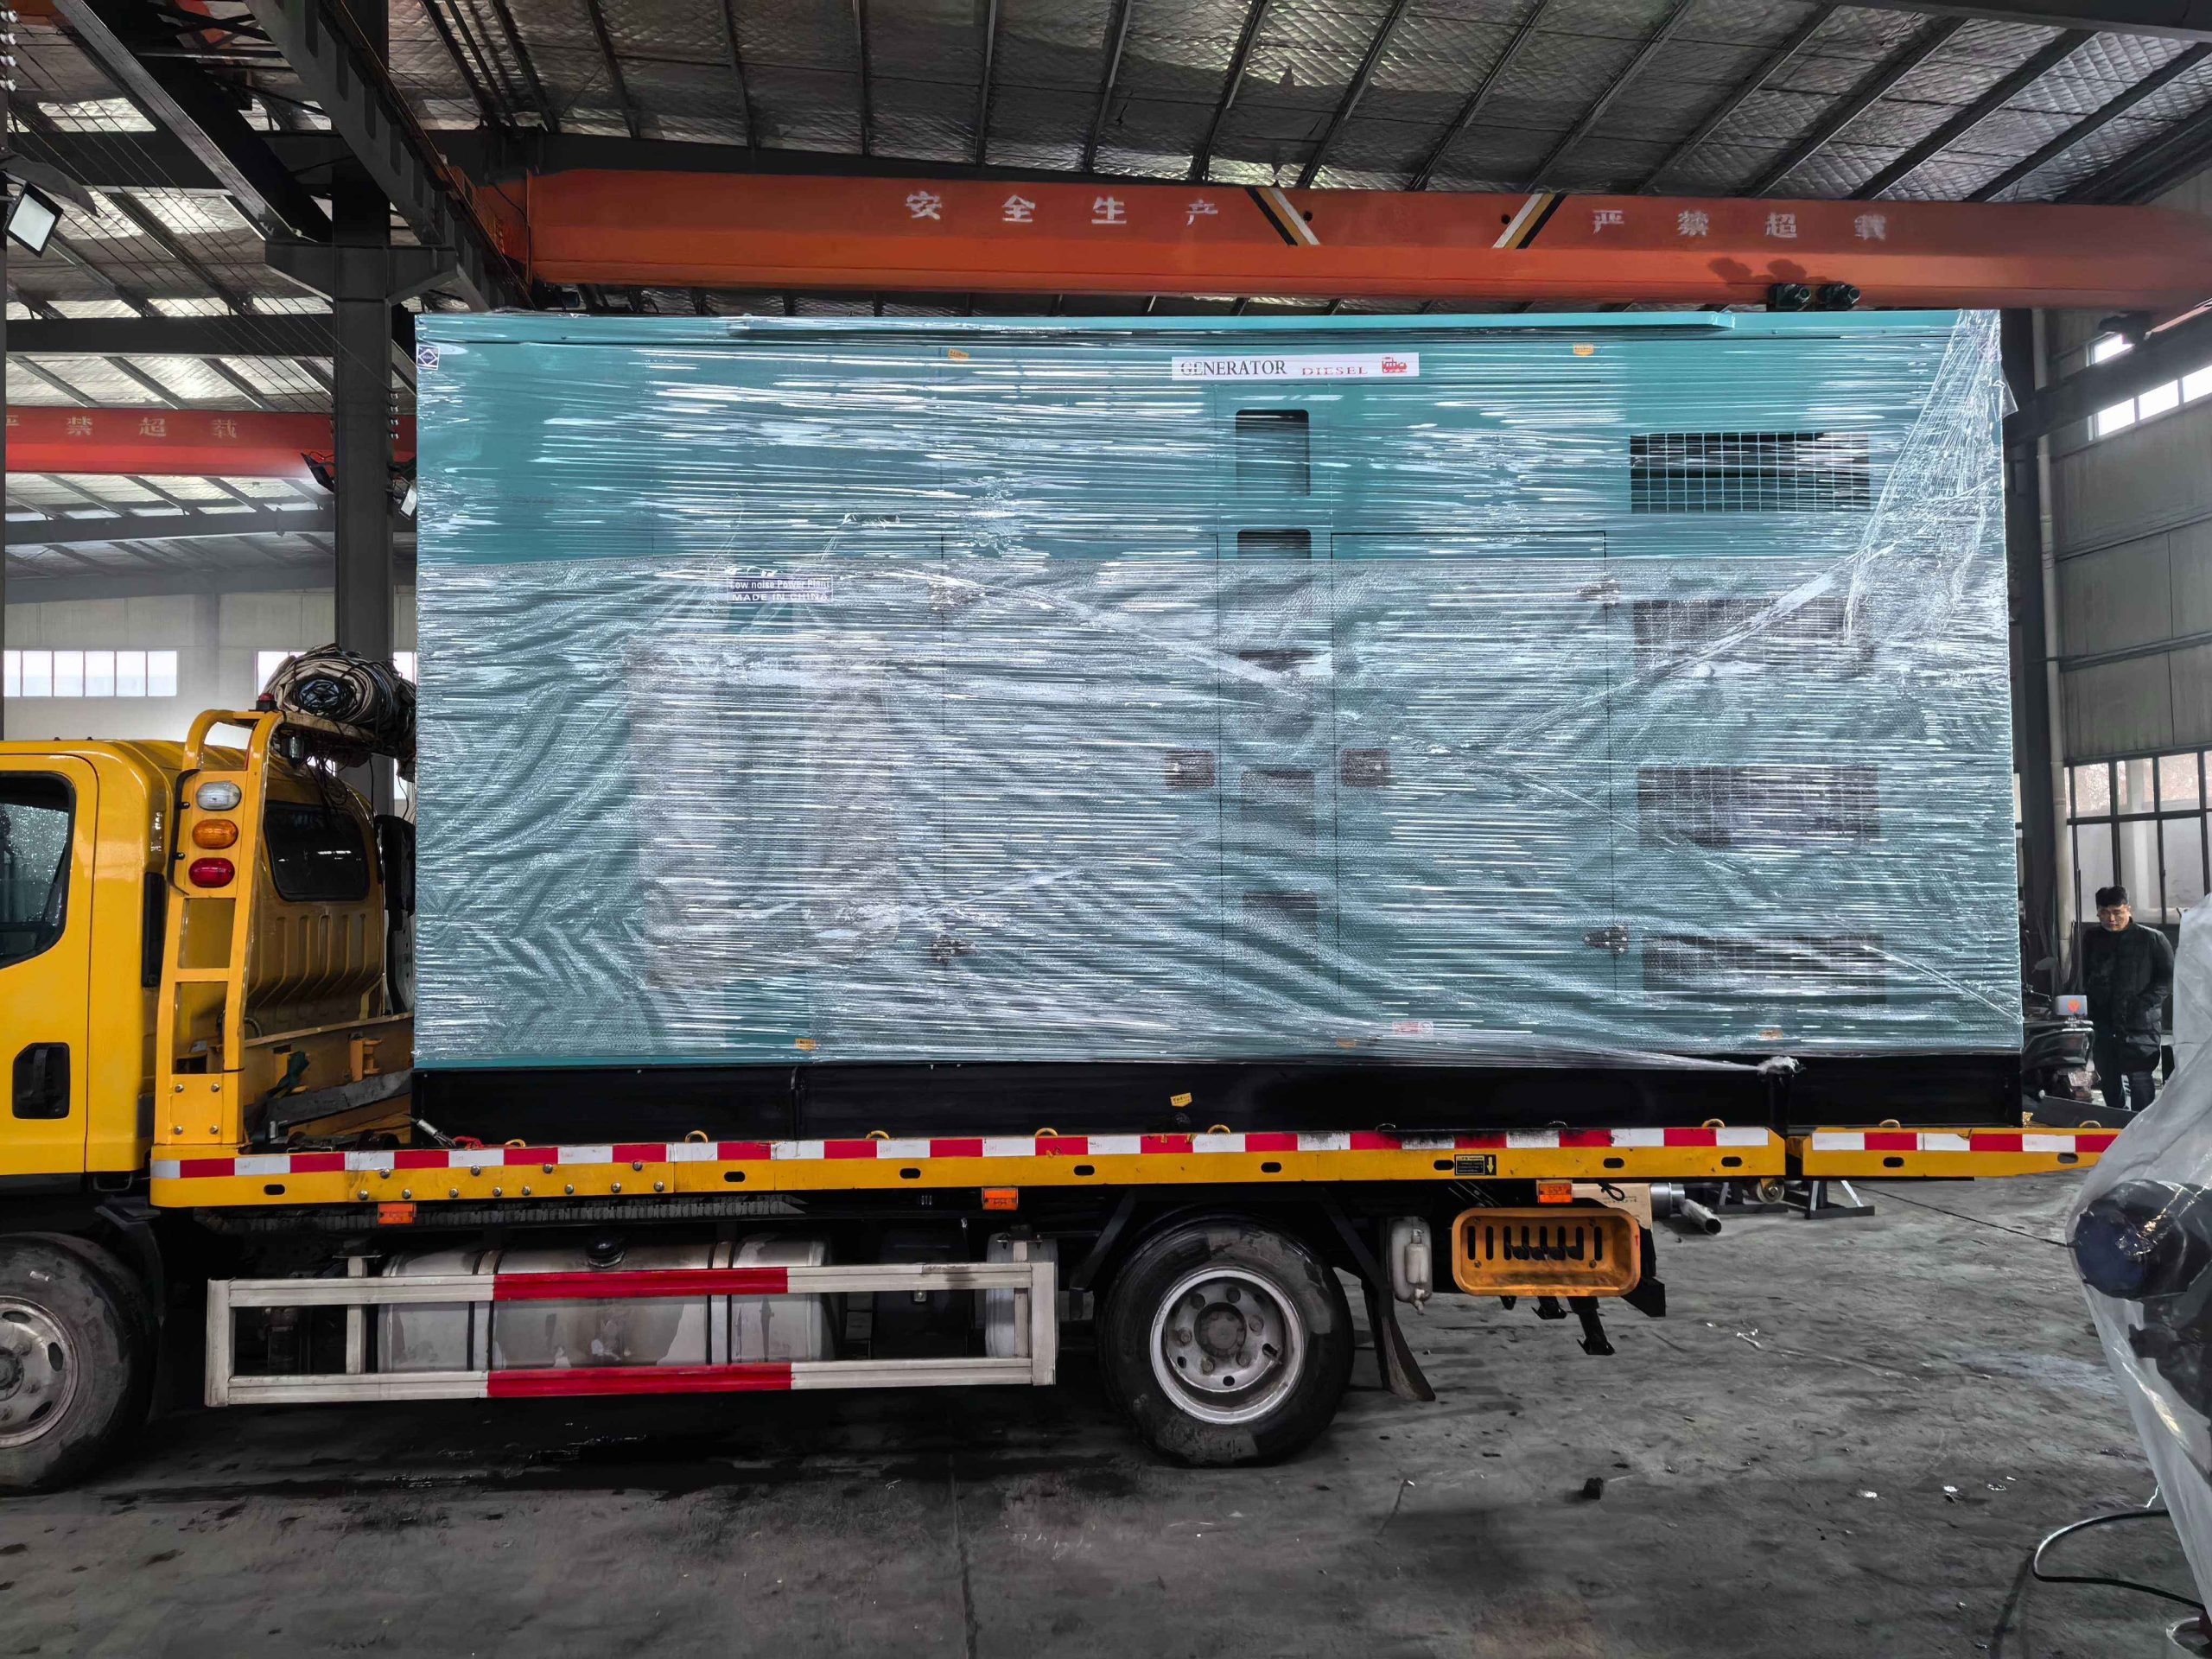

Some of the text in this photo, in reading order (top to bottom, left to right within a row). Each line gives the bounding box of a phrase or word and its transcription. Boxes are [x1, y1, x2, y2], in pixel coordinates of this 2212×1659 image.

[906, 191, 1218, 226] 安全生产
[1180, 359, 1368, 376] GENERATOR DIESEL
[751, 580, 776, 589] noise
[778, 580, 804, 589] Power
